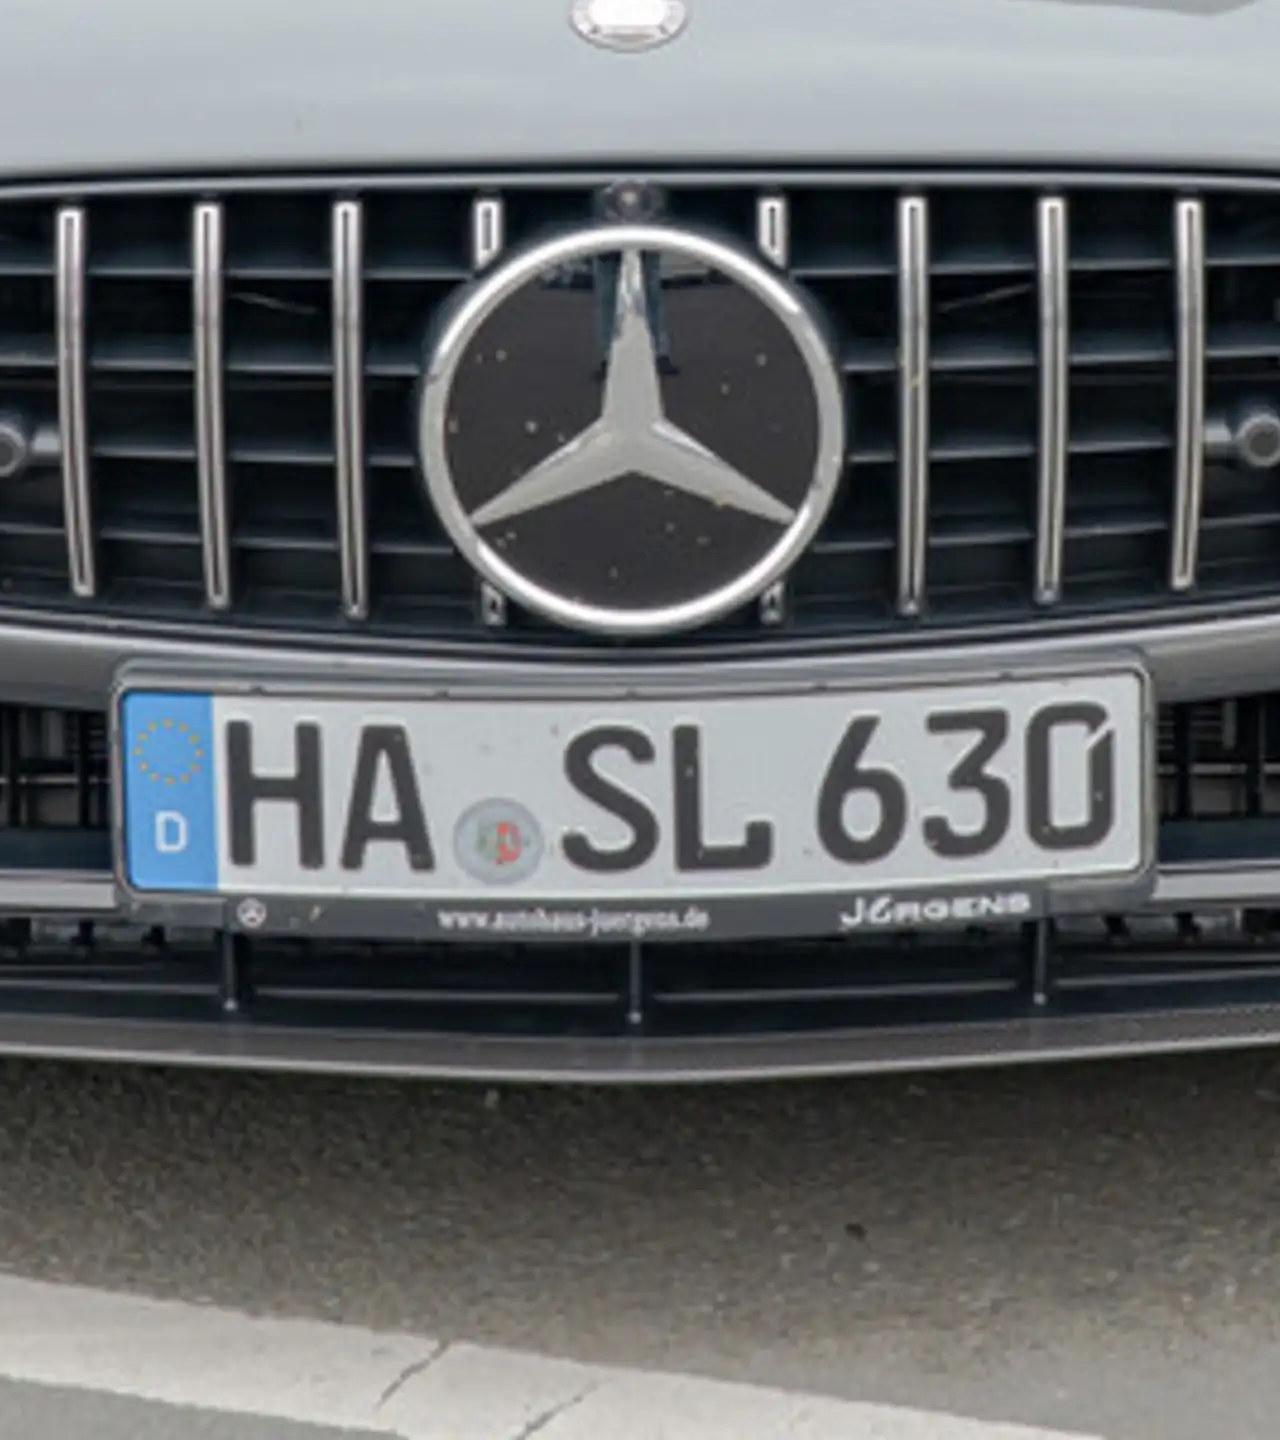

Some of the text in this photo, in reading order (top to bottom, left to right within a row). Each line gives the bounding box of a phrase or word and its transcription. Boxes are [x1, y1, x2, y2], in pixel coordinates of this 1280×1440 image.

[154, 809, 188, 854] D
[226, 701, 1116, 873] HA SL 630
